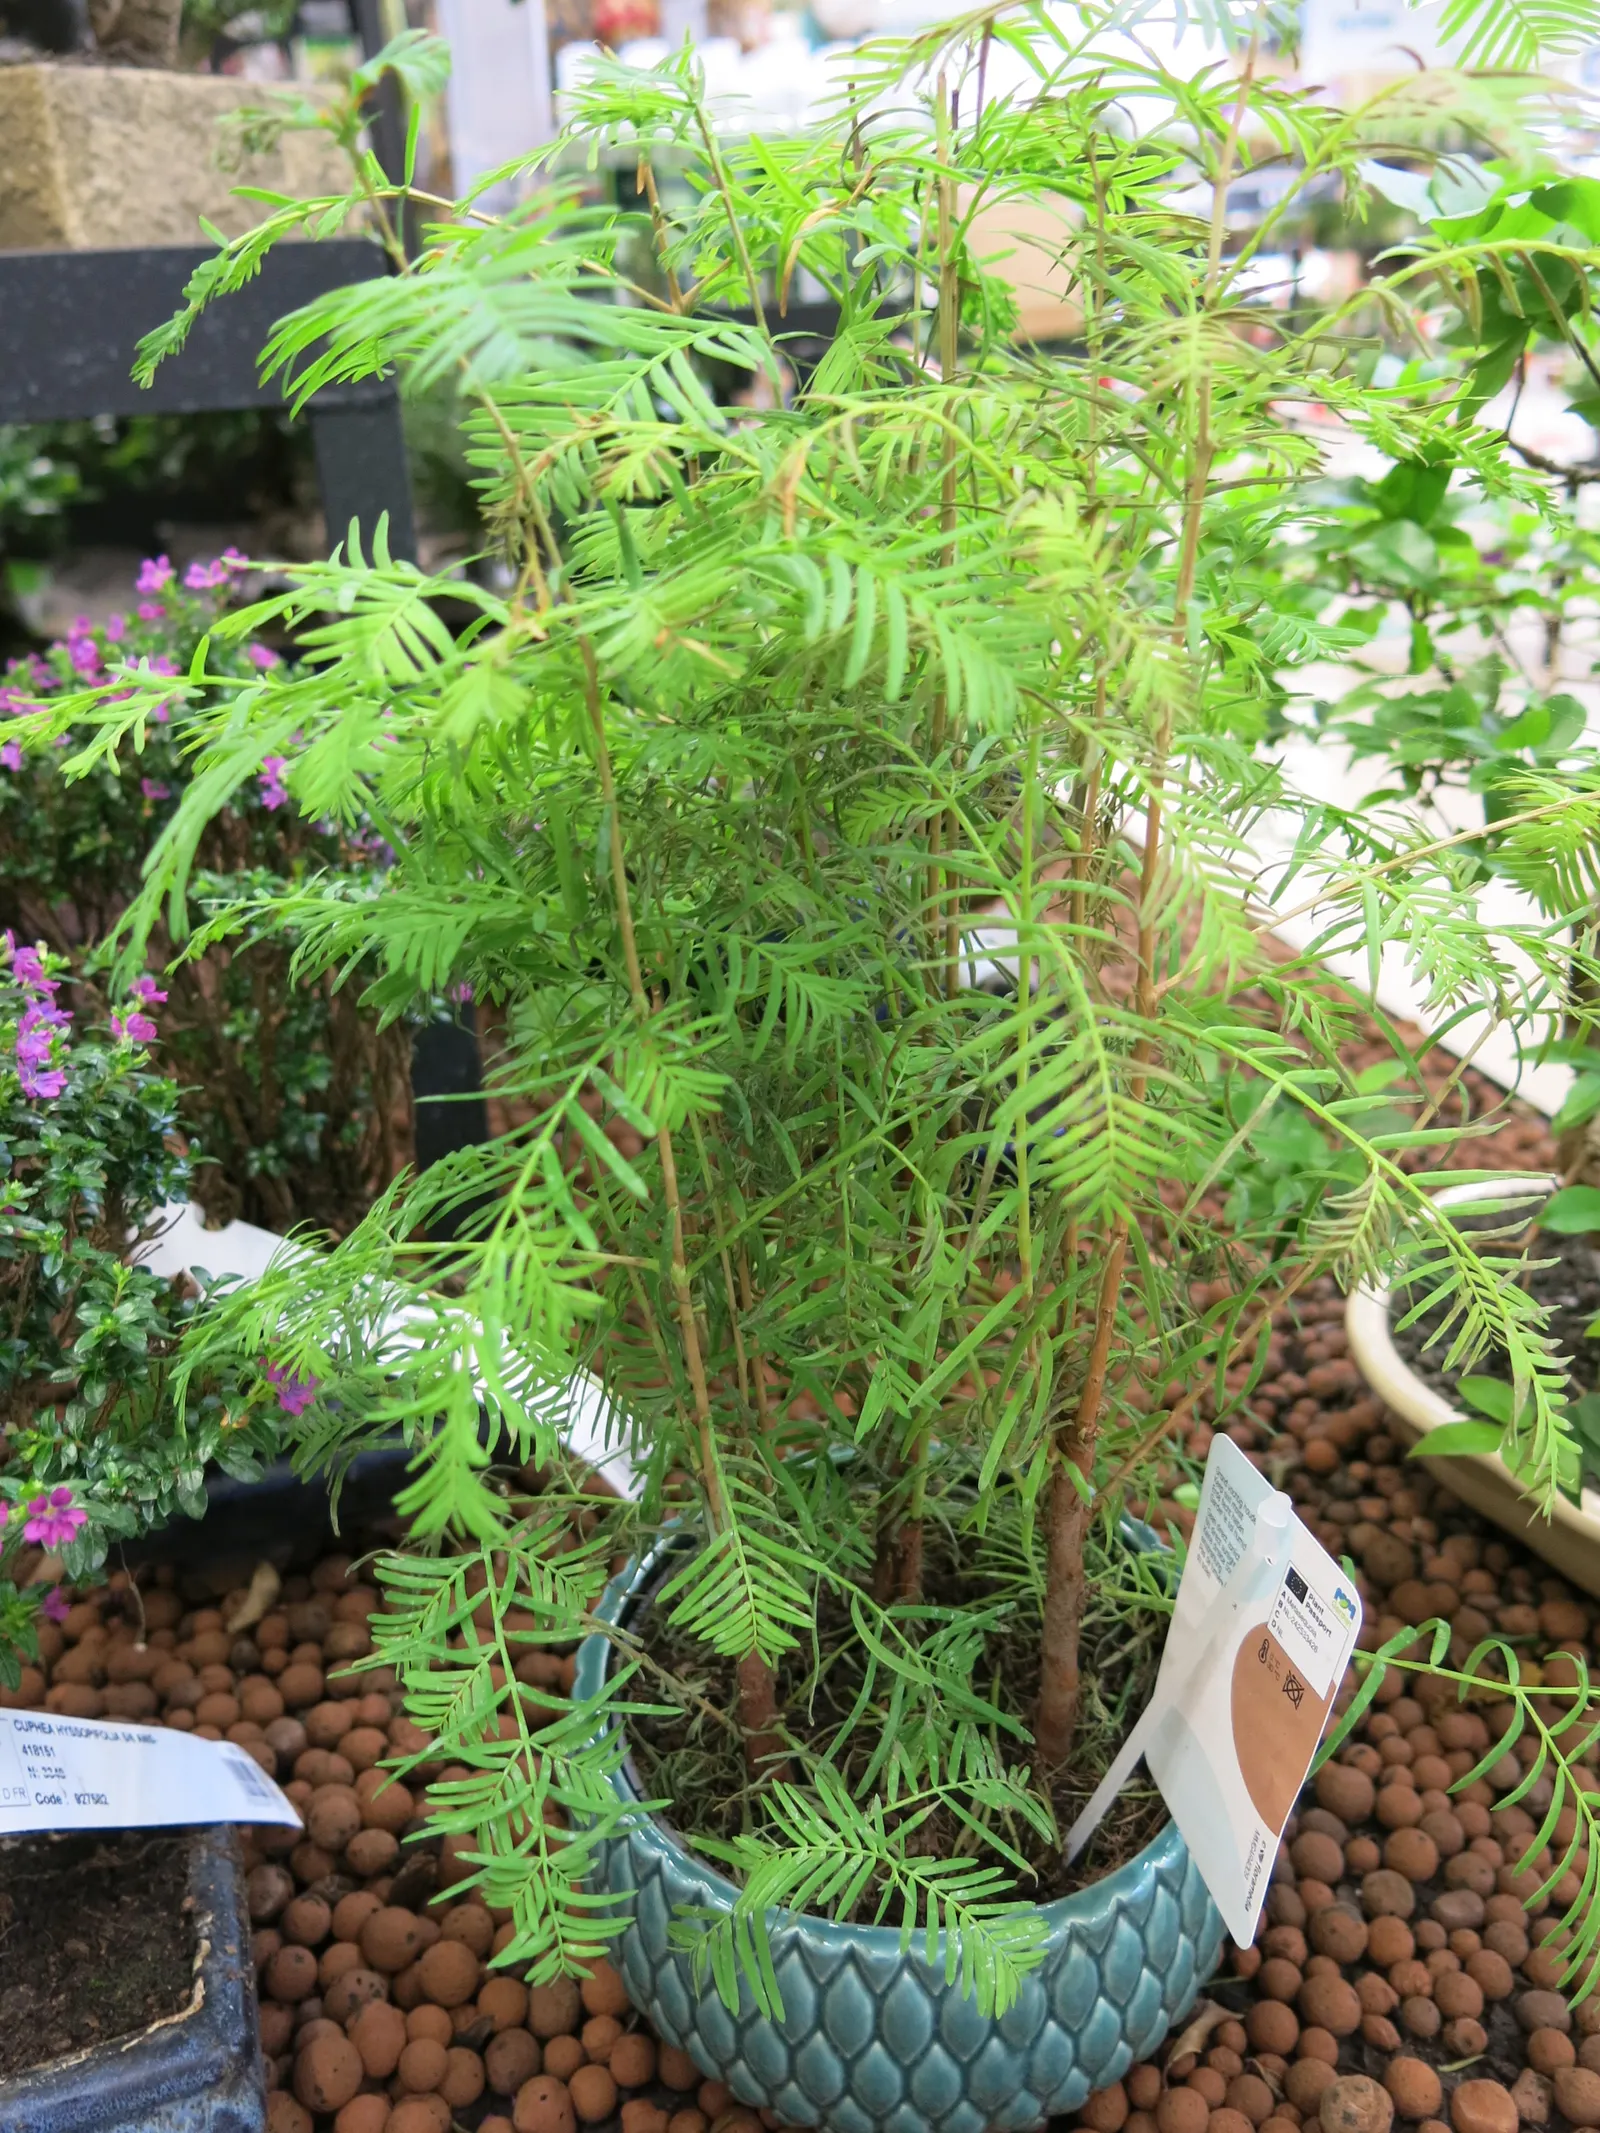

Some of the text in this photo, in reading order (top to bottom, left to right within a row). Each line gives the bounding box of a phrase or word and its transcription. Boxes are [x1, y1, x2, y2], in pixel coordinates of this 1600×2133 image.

[1281, 1591, 1287, 1599] A
[1278, 1600, 1284, 1609] B
[1308, 1593, 1324, 1616] Plant
[1275, 1610, 1280, 1619] C
[1305, 1602, 1332, 1638] Passport
[1271, 1619, 1277, 1628] D
[13, 1719, 54, 1734] CUPHEA
[22, 1744, 56, 1757] 418151
